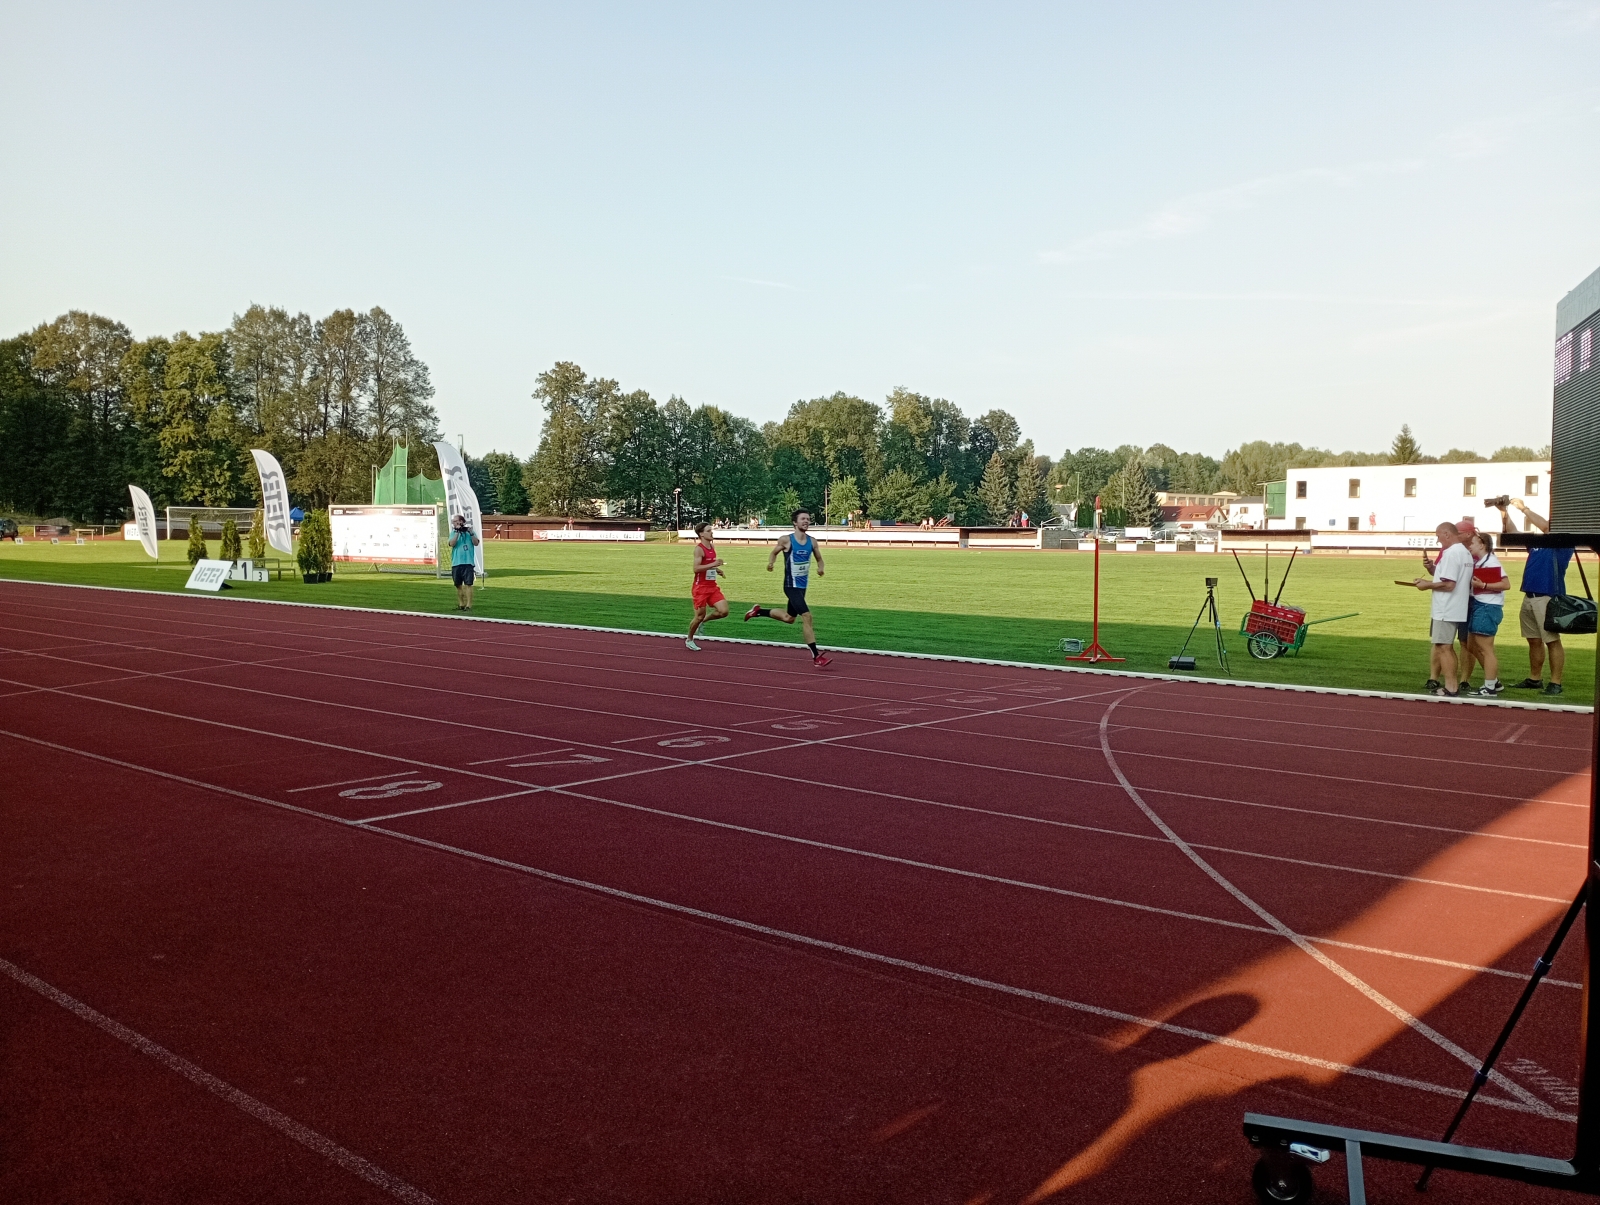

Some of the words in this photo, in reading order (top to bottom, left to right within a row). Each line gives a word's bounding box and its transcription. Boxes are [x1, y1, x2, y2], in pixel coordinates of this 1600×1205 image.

[228, 569, 233, 580] 2
[241, 561, 248, 580] 1
[258, 571, 263, 582] 3
[337, 779, 444, 800] 8
